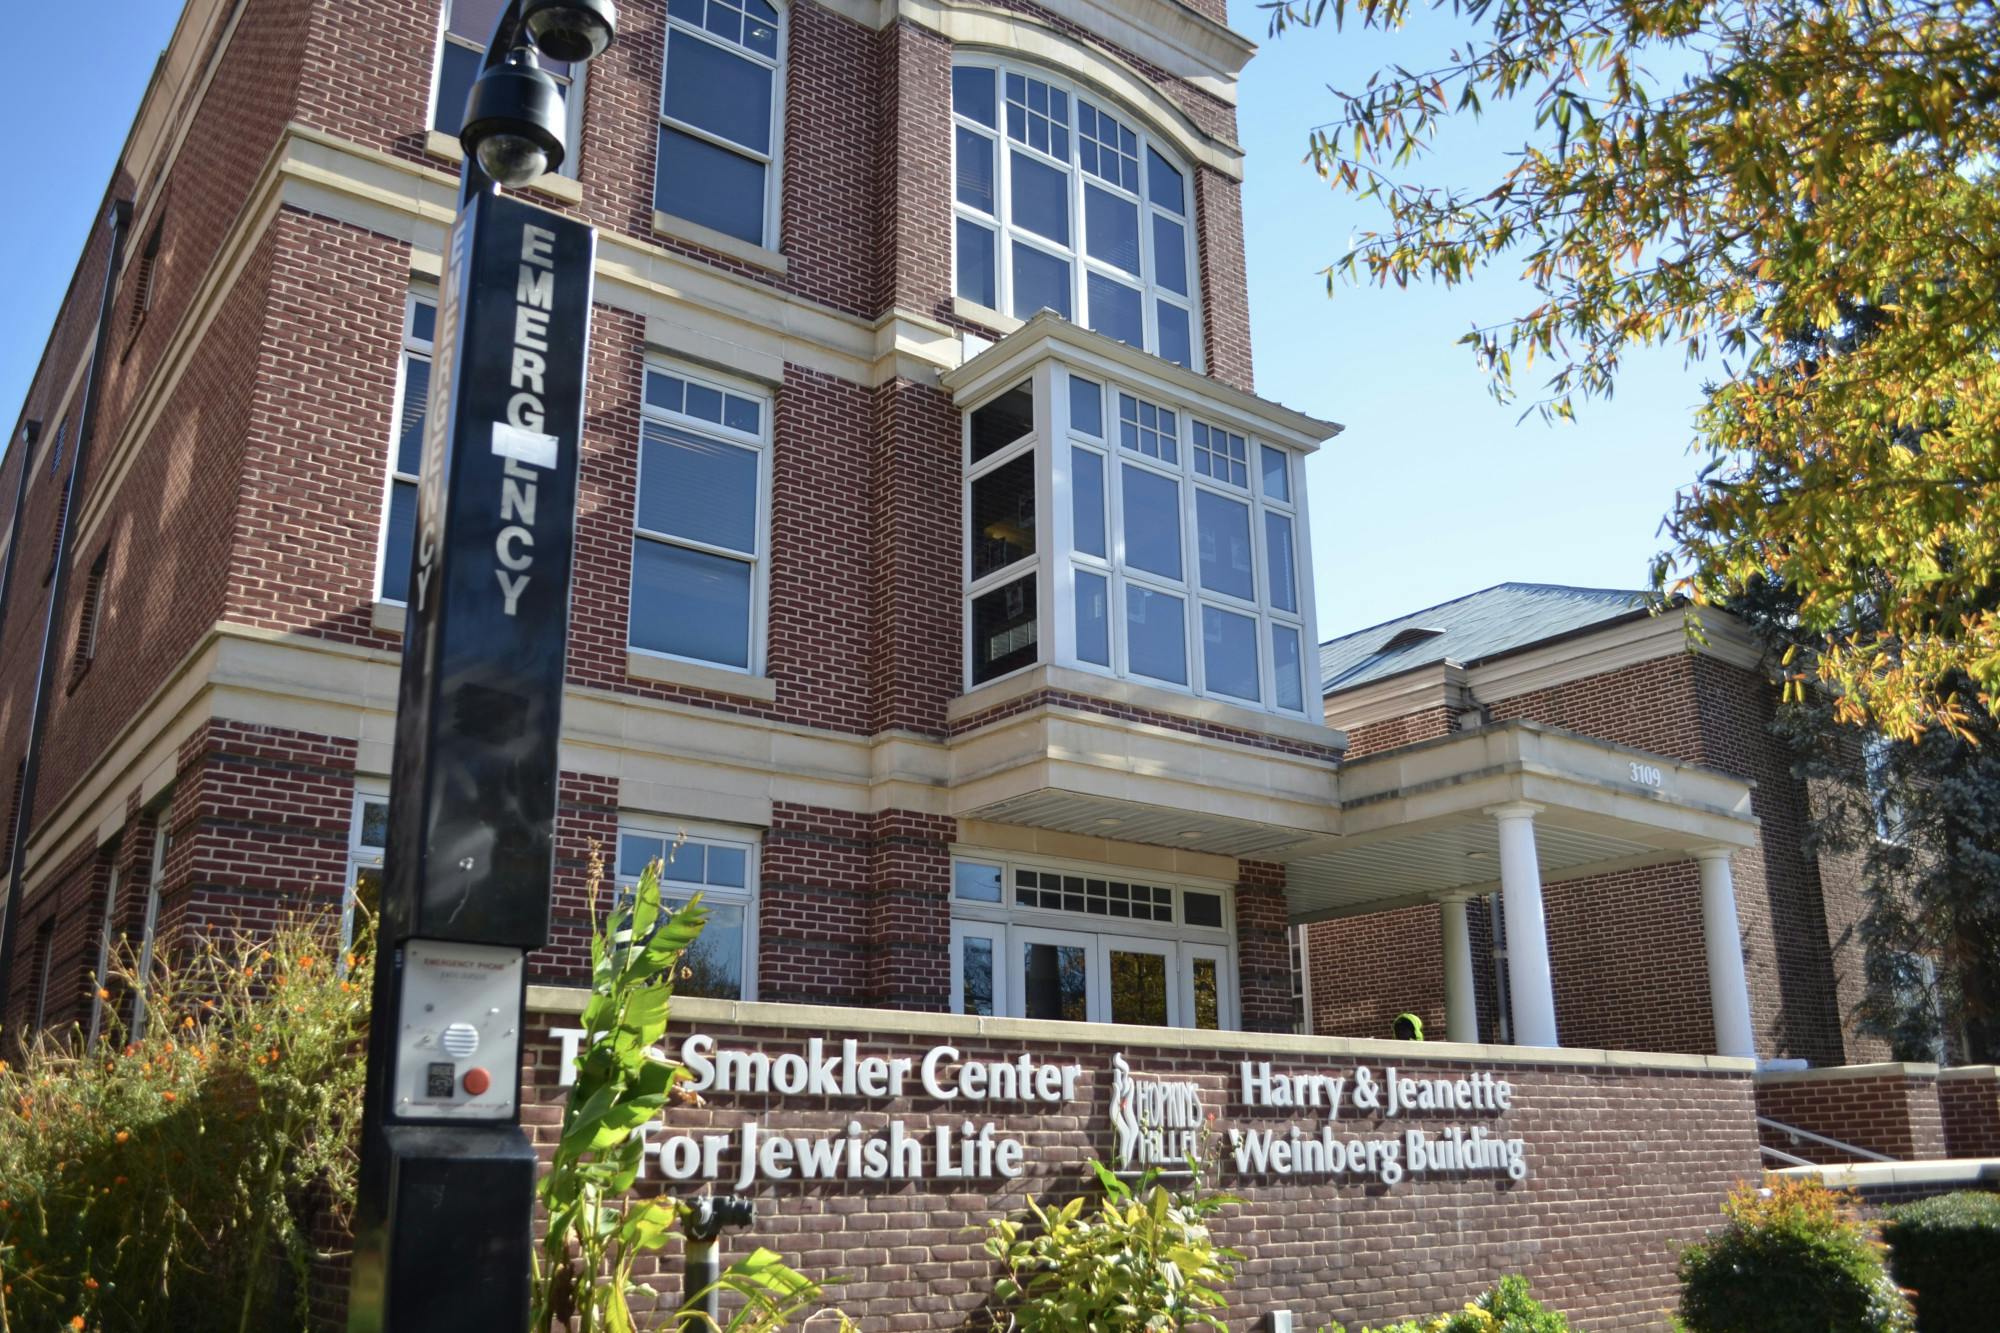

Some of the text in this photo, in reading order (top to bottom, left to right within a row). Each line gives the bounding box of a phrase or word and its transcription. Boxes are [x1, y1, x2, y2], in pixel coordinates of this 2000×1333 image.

[416, 224, 466, 612] EMERGENCY
[1629, 762, 1661, 787] 3109
[681, 1033, 912, 1098] Smokler
[920, 1045, 1082, 1102] Center
[1240, 1060, 1513, 1121] Harry & Jeanette
[1136, 1080, 1203, 1128] HOPKINS
[631, 1119, 1025, 1191] For Jewish Life
[1228, 1125, 1527, 1186] Weinberg Building
